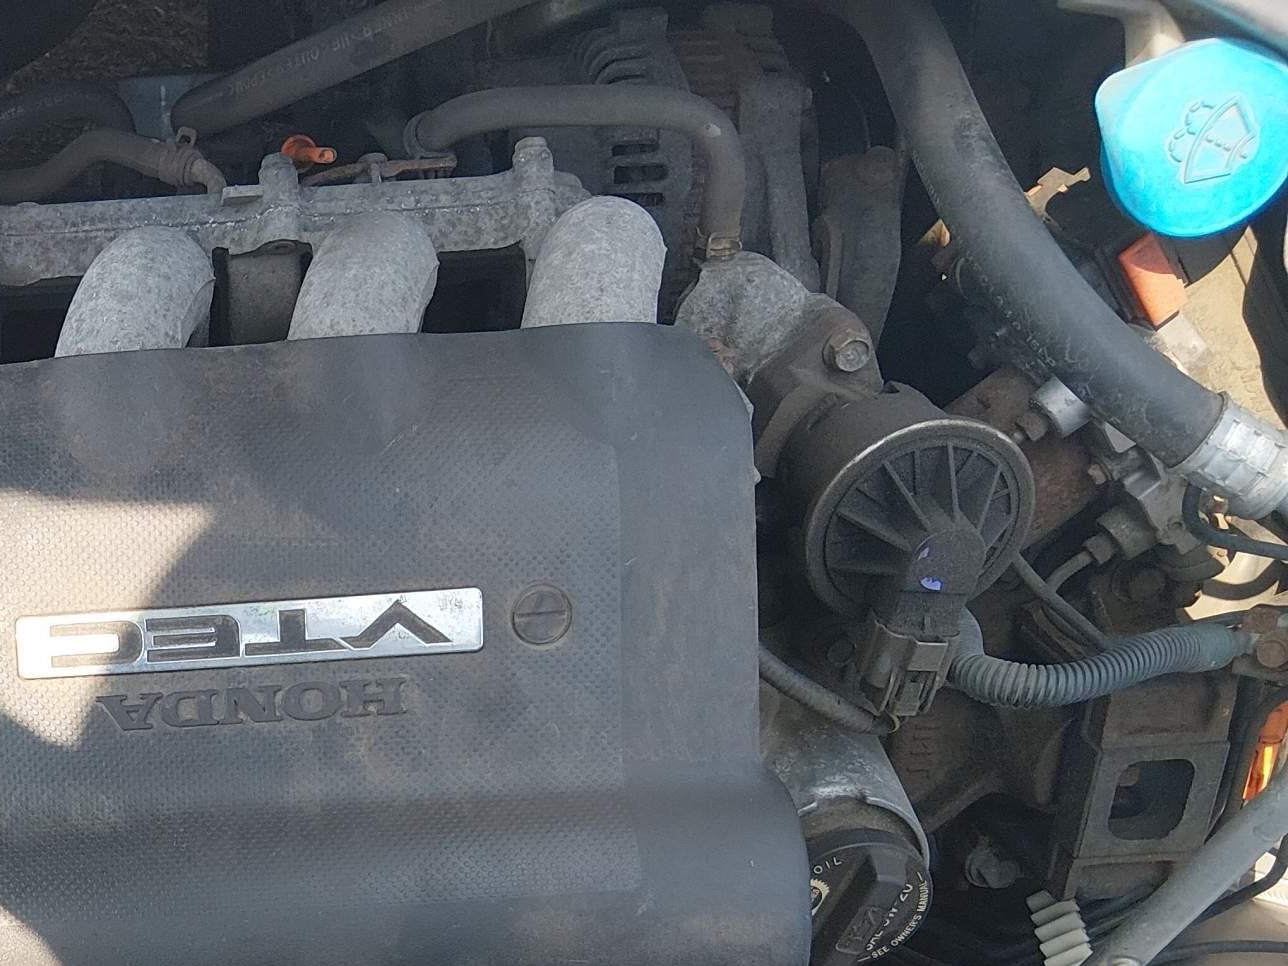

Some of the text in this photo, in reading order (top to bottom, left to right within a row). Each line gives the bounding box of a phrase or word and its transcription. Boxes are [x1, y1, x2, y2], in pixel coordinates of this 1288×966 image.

[48, 599, 454, 671] VTEC
[95, 676, 408, 733] HONDA
[813, 856, 843, 875] OIL
[871, 946, 891, 959] SEE
[917, 879, 930, 913] MANUAL
